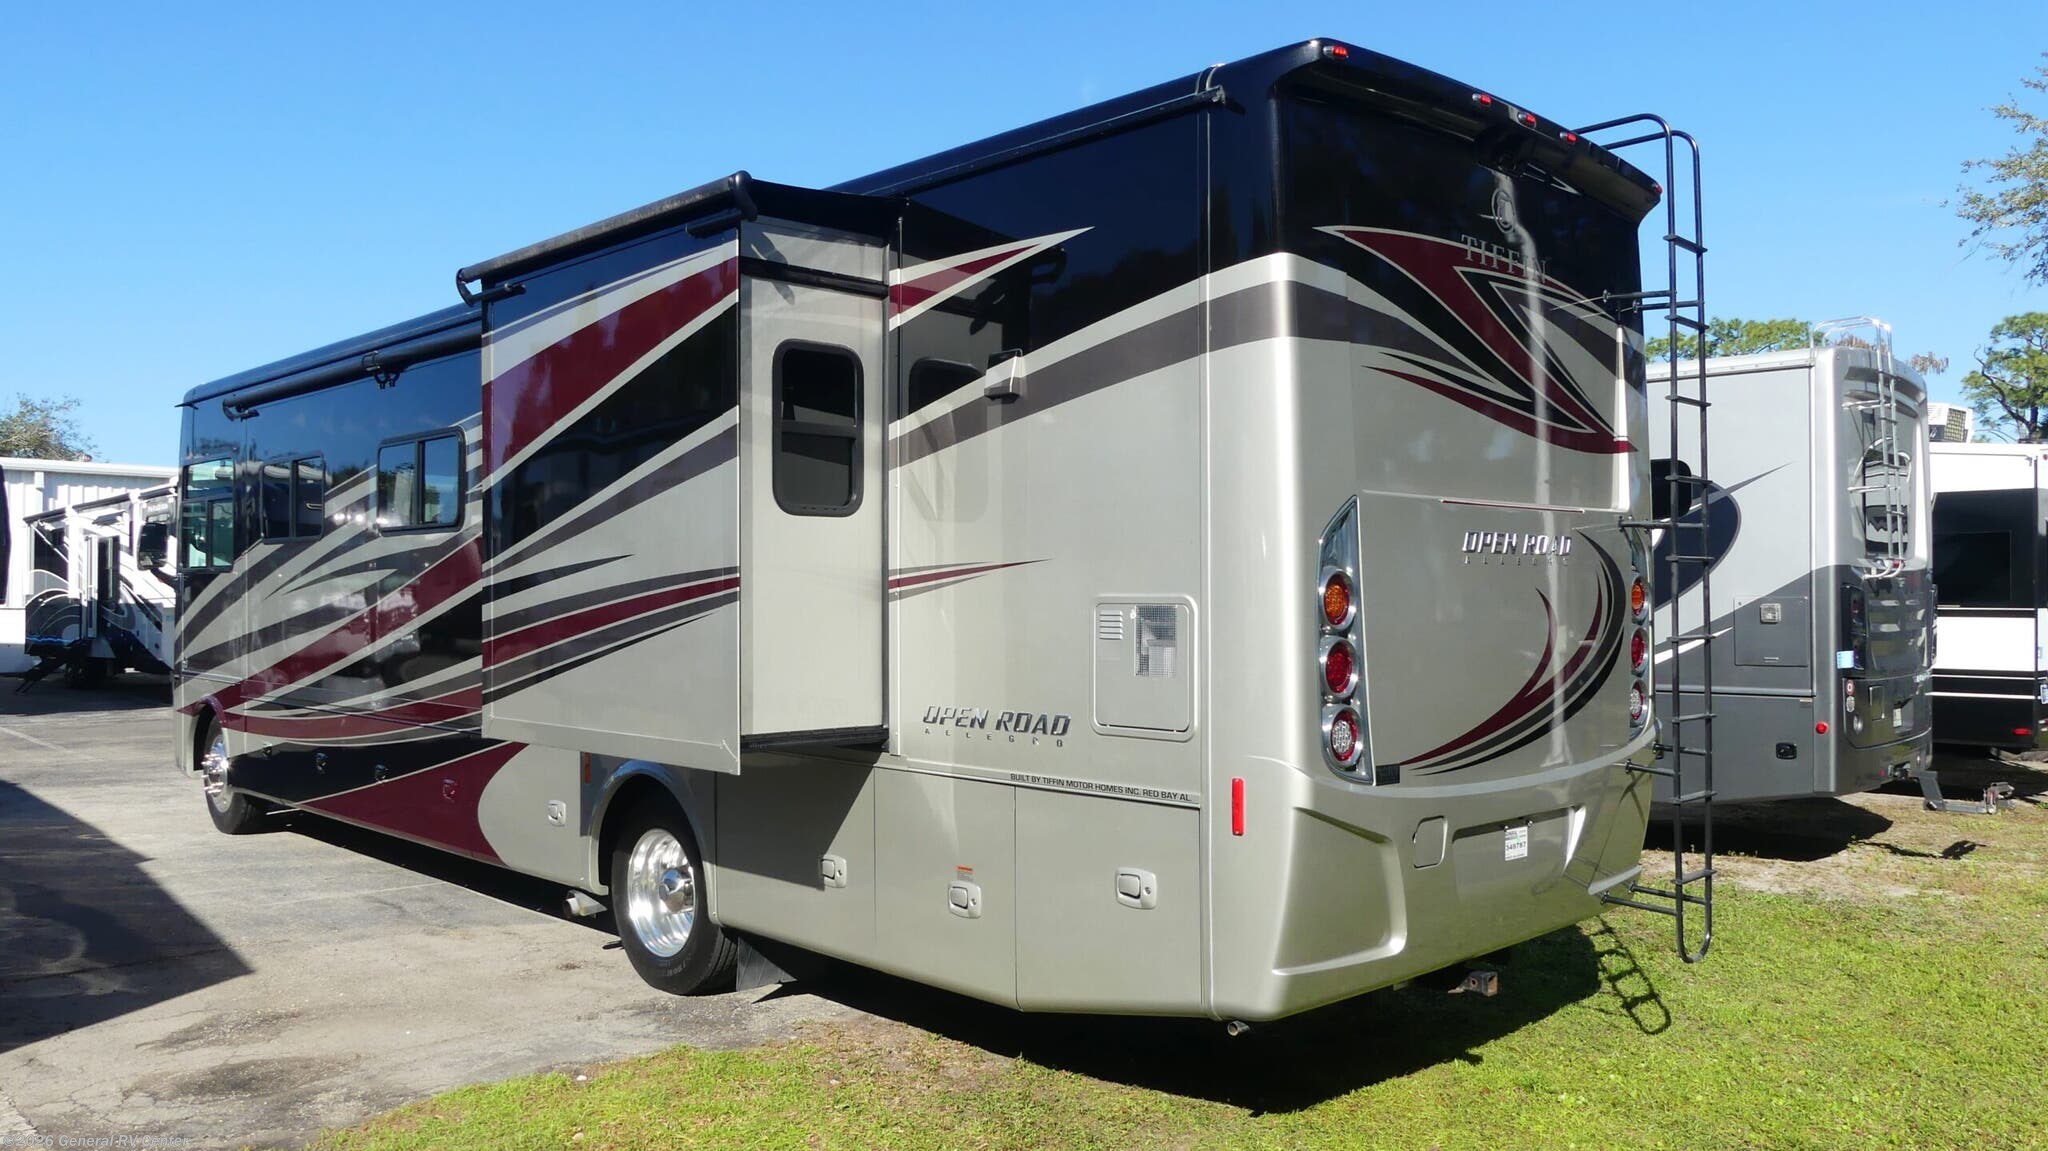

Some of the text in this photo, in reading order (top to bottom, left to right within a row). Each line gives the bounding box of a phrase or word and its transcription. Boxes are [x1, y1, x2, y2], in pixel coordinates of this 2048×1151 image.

[1461, 234, 1546, 284] TIFFIN
[1462, 531, 1572, 556] OPEN ROAD
[923, 705, 1072, 736] OPEN ROAD
[924, 726, 1064, 748] ALLEGRO
[1010, 773, 1030, 782] BUILT
[1031, 775, 1041, 783] BY
[1042, 777, 1065, 786] TIFFIN
[1066, 780, 1093, 790] MOTOR
[1095, 783, 1123, 794] HOMES
[1143, 788, 1159, 798] RED
[1161, 790, 1178, 800] BAY
